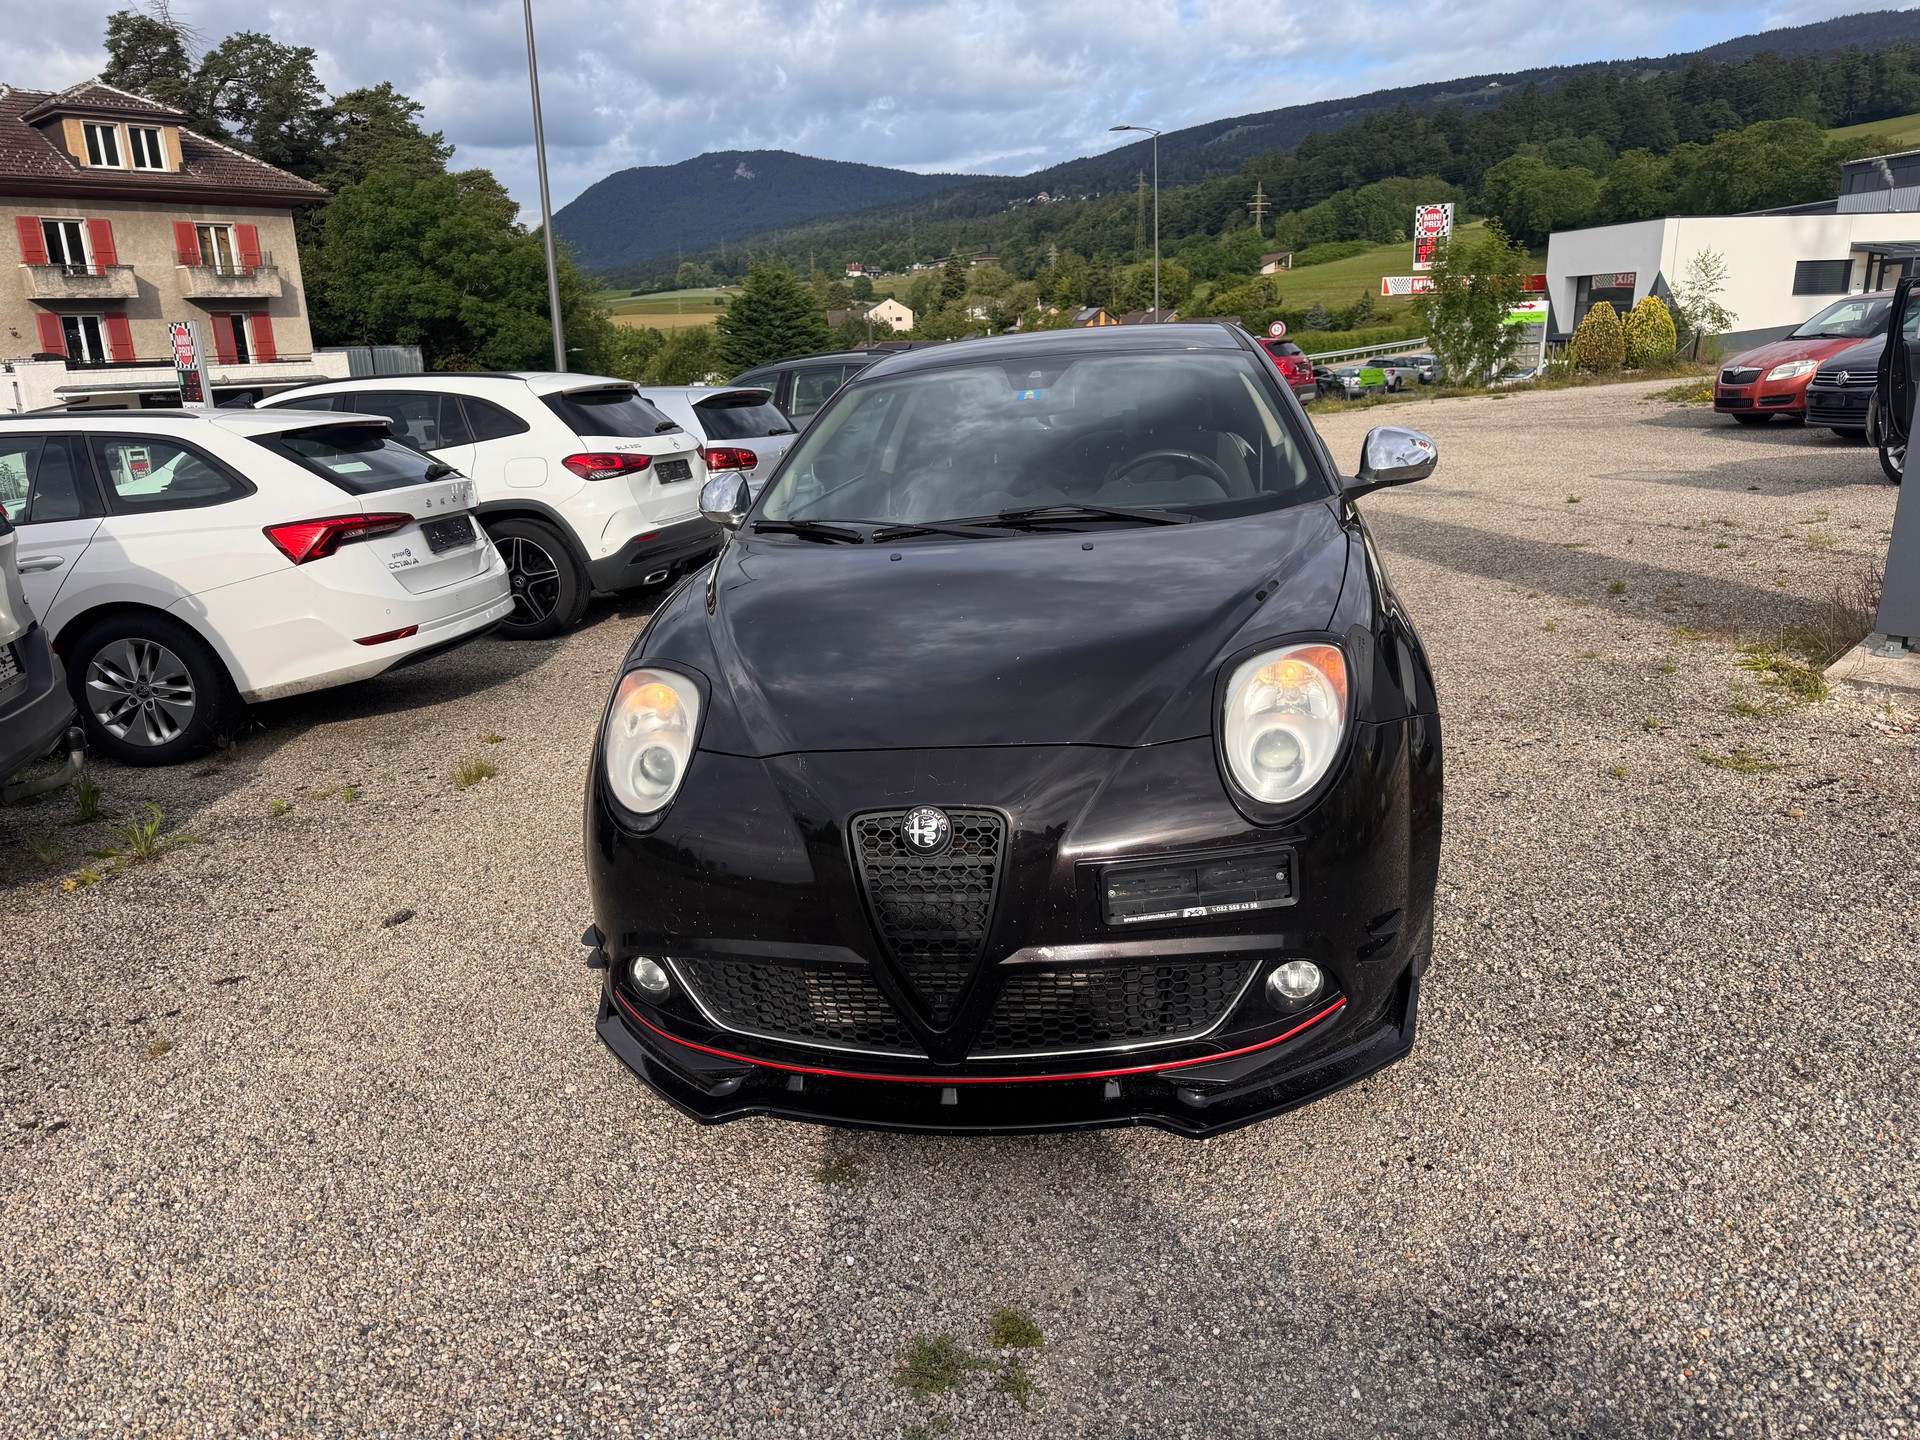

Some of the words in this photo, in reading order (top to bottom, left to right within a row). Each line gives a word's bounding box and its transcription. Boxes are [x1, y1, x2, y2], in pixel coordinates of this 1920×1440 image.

[1423, 213, 1442, 221] MINI
[1423, 220, 1442, 229] PRIX
[177, 334, 190, 345] MINI
[178, 346, 191, 356] PRIX
[904, 811, 920, 832] ALFA
[921, 808, 947, 831] ROMEO
